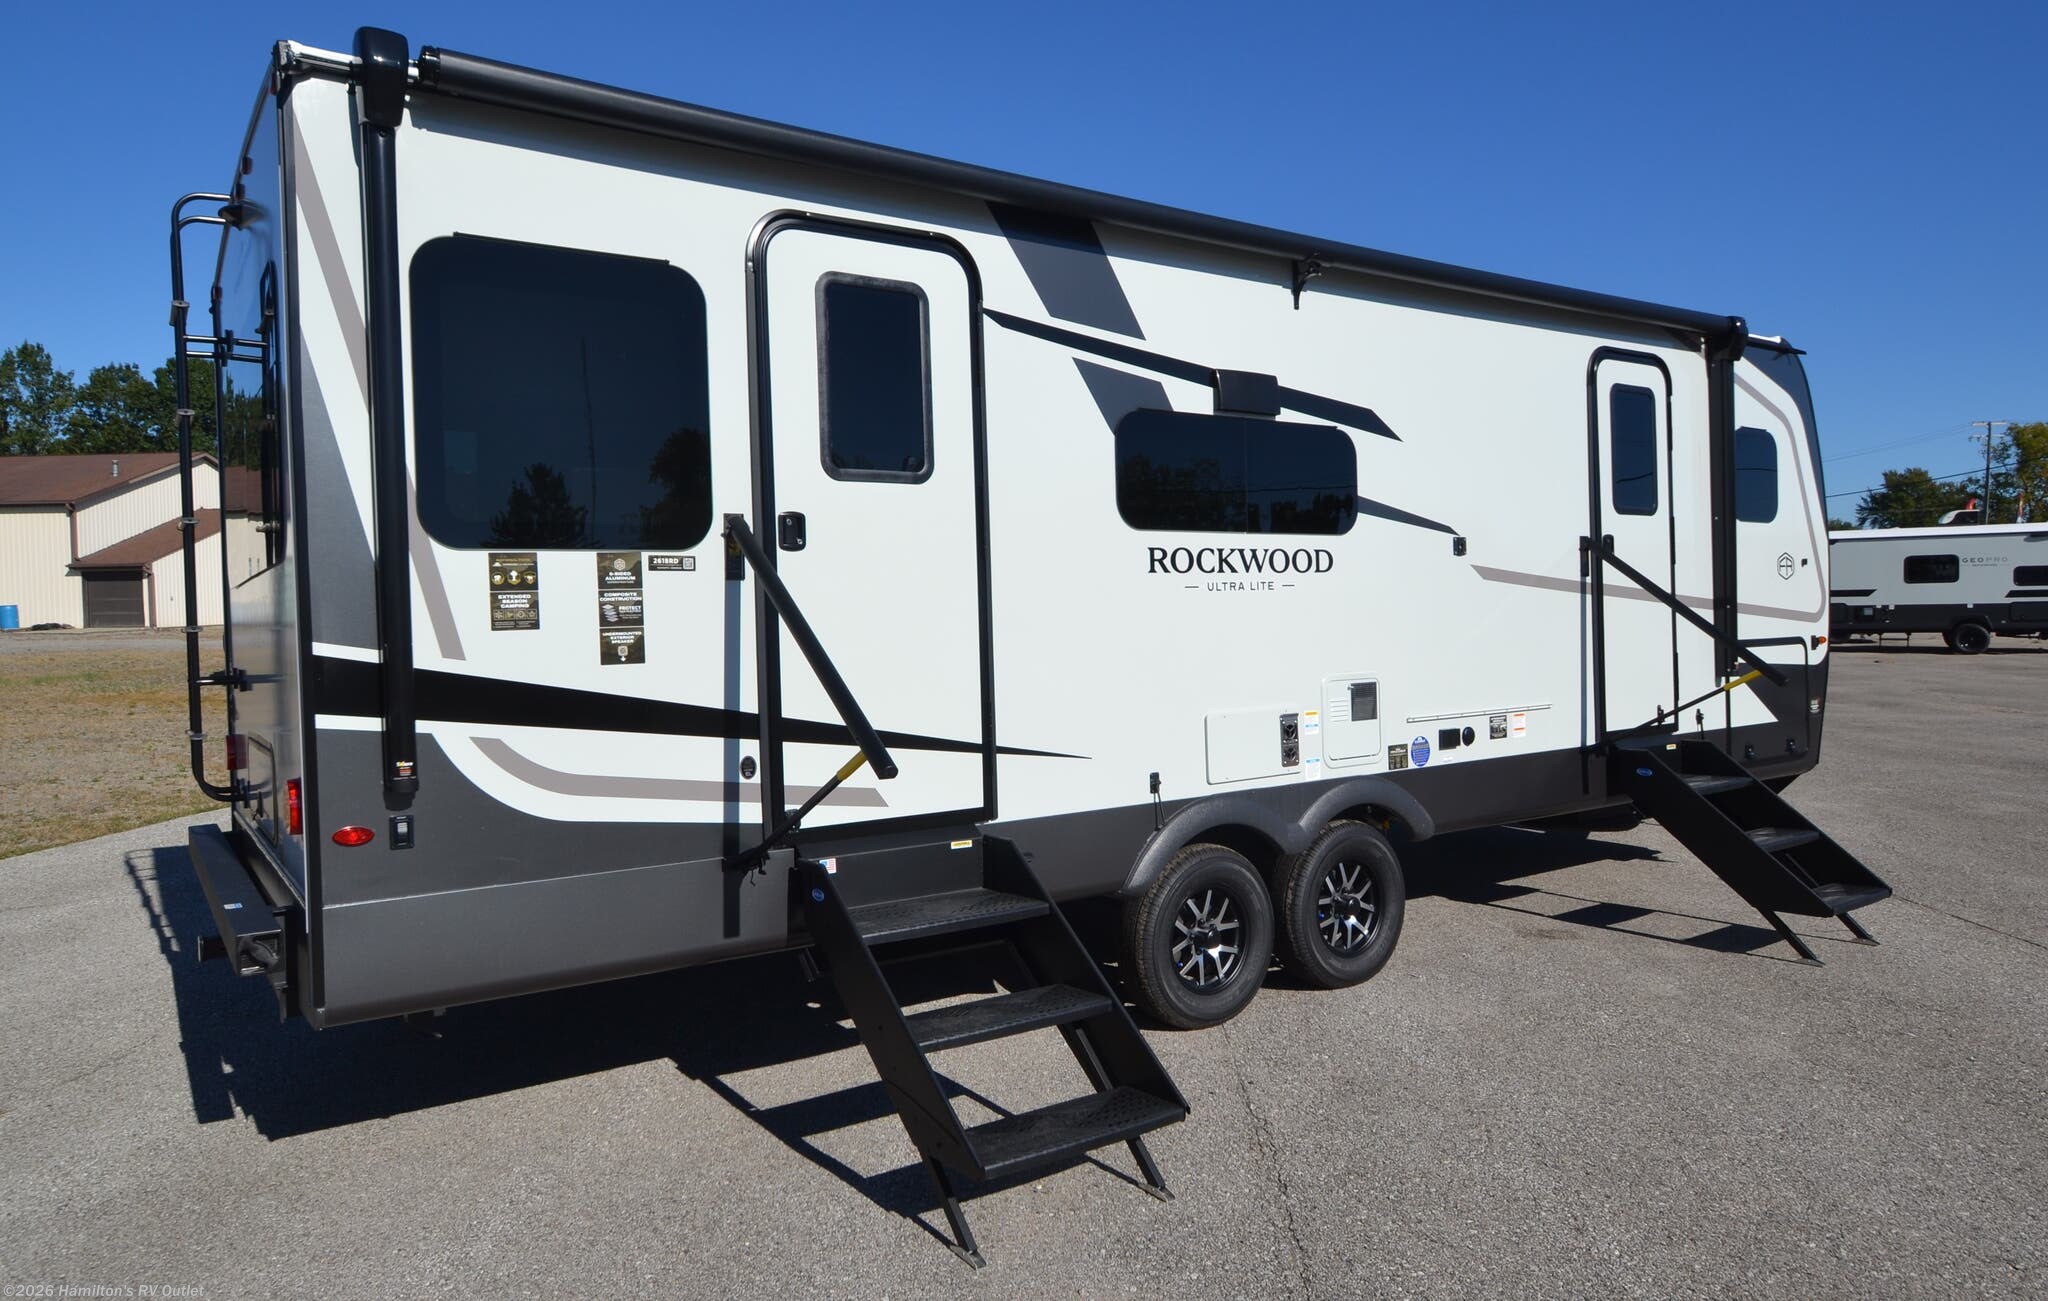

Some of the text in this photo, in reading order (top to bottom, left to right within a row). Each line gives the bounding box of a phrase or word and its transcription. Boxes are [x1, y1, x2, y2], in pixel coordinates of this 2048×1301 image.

[1147, 547, 1334, 574] ROCKWOOD
[1207, 582, 1274, 591] ULTRA LITE
